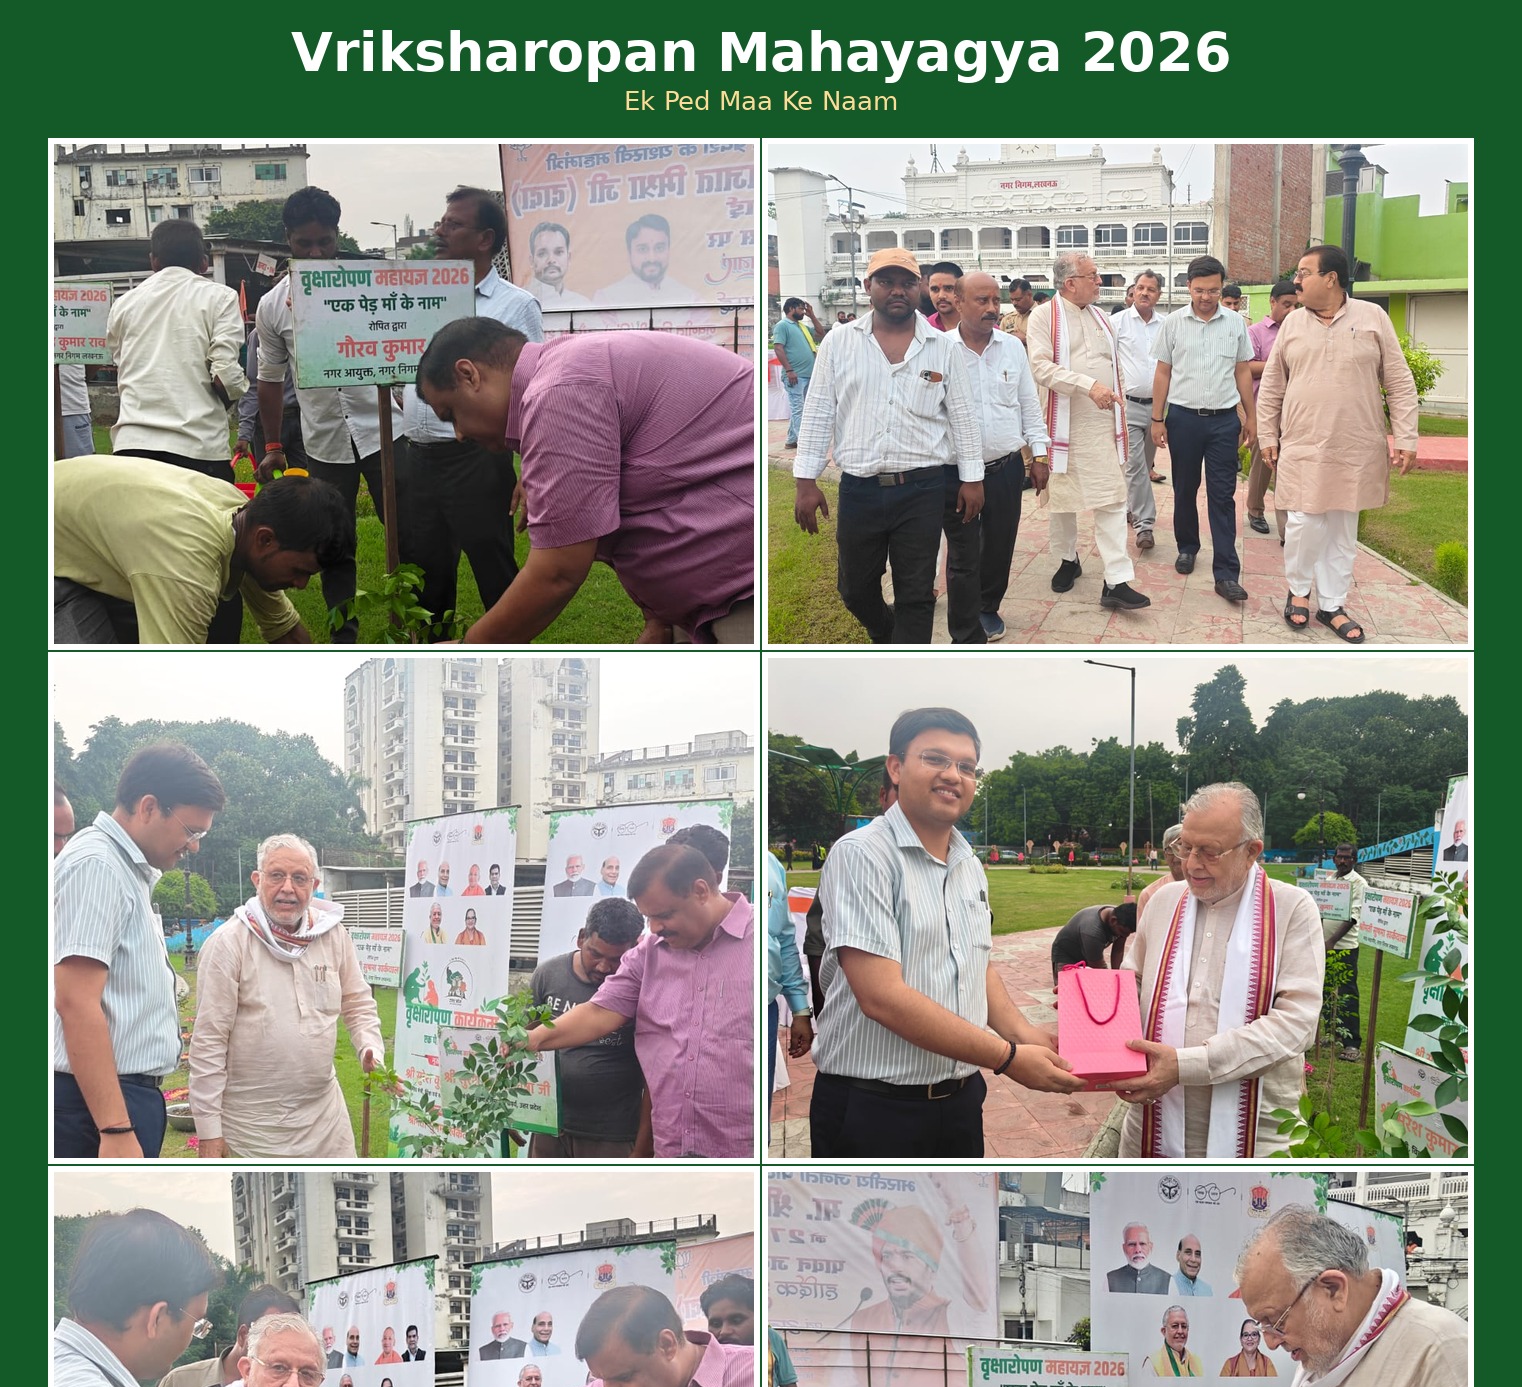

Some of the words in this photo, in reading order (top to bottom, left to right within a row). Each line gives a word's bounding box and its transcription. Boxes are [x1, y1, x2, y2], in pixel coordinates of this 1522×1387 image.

[1000, 181, 1013, 189] नगर
[300, 265, 372, 295] वृक्षारोपण
[374, 268, 428, 286] महायज्ञ
[432, 268, 469, 285] 2026
[80, 290, 107, 301] 2026
[324, 299, 354, 312] "एक
[359, 295, 377, 315] पेड़
[381, 292, 397, 311] माँ
[400, 293, 414, 309] के
[418, 297, 446, 309] नाम"
[369, 321, 389, 330] रोपित
[392, 322, 406, 332] द्वारा
[58, 337, 86, 350] कुमार
[88, 338, 106, 347] राव
[337, 335, 377, 358] गौरव
[382, 339, 426, 362] कुमार
[324, 368, 341, 378] नगर
[379, 365, 395, 376] नगर
[1398, 898, 1411, 908] 2026
[547, 996, 561, 1011] BE
[538, 1081, 551, 1096] जी
[980, 1354, 1043, 1380] वृक्षारोपण
[1045, 1360, 1091, 1376] महायज्ञ
[1094, 1361, 1125, 1376] 2026
